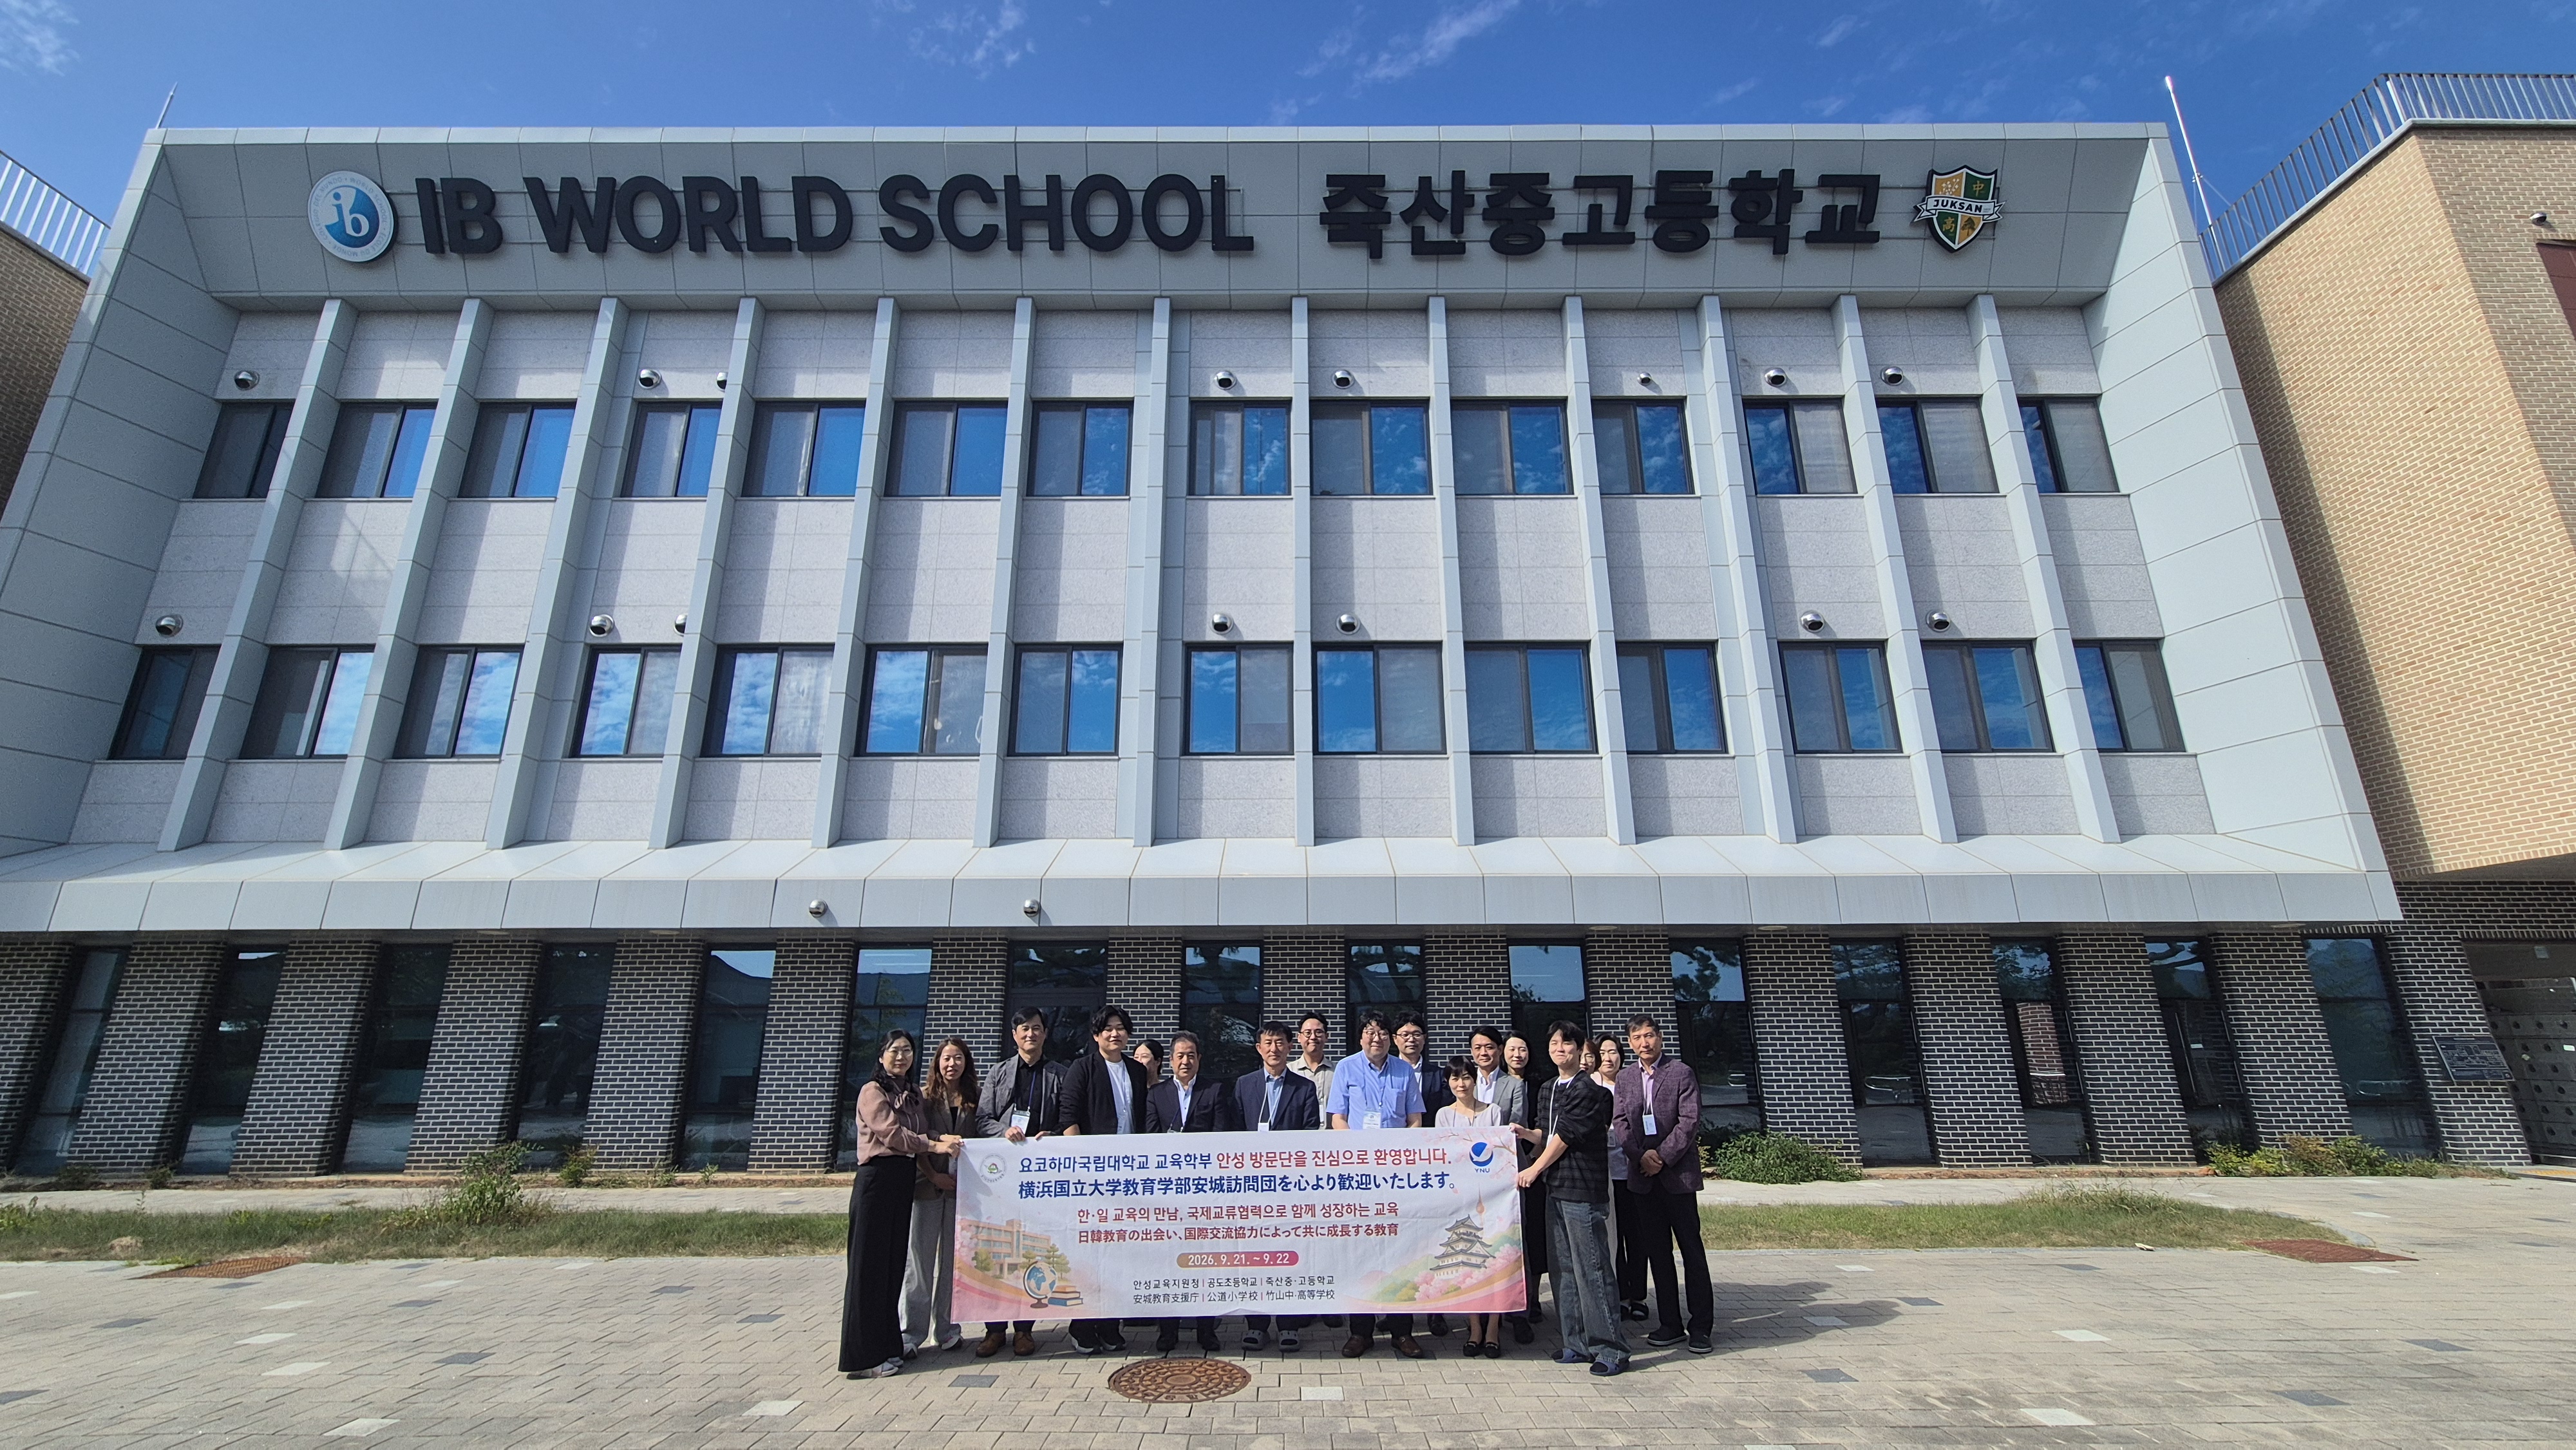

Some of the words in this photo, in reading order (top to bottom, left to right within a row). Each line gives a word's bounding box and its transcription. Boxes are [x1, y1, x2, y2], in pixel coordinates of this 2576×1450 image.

[1973, 180, 1985, 197] 中
[415, 177, 504, 255] IB
[523, 175, 853, 253] WORLD
[878, 173, 1255, 252] SCHOOL
[1319, 169, 1882, 259] 죽산중고등학교
[1933, 199, 1983, 213] JUKSAN
[1942, 216, 1955, 232] 高
[1019, 1154, 1150, 1172] 요코하마국립대학교
[1155, 1152, 1212, 1170] 교육학부
[1217, 1152, 1245, 1169] 안성
[1249, 1150, 1307, 1169] 방문단을
[1312, 1149, 1370, 1167] 진심으로
[1374, 1148, 1452, 1166] 환영합니다.
[1018, 1171, 1455, 1199] 横浜国立大学教育学部安城訪問団を心より歓迎いたします。
[1078, 1209, 1108, 1223] 한·일
[1112, 1207, 1150, 1222] 교육의
[1154, 1207, 1183, 1222] 만남,
[1187, 1205, 1287, 1221] 국제교류협력으로
[1291, 1203, 1316, 1219] 함께
[1320, 1203, 1370, 1218] 성장하는
[1374, 1201, 1399, 1216] 교육
[1078, 1223, 1399, 1244] 日韓教育の出会い、国際交流協力によって共に成長する教育
[1188, 1254, 1217, 1265] 2026.
[1221, 1254, 1231, 1265] 9.
[1233, 1254, 1250, 1265] 21.
[1263, 1253, 1273, 1264] 9.
[1276, 1253, 1289, 1264] 22
[1133, 1278, 1200, 1290] 안성교육지원청
[1207, 1277, 1258, 1287] 공도초등학교
[1265, 1276, 1335, 1286] 죽산중·고등학교
[1133, 1292, 1200, 1304] 安城教育支援庁
[1207, 1290, 1258, 1302] 公道小学校
